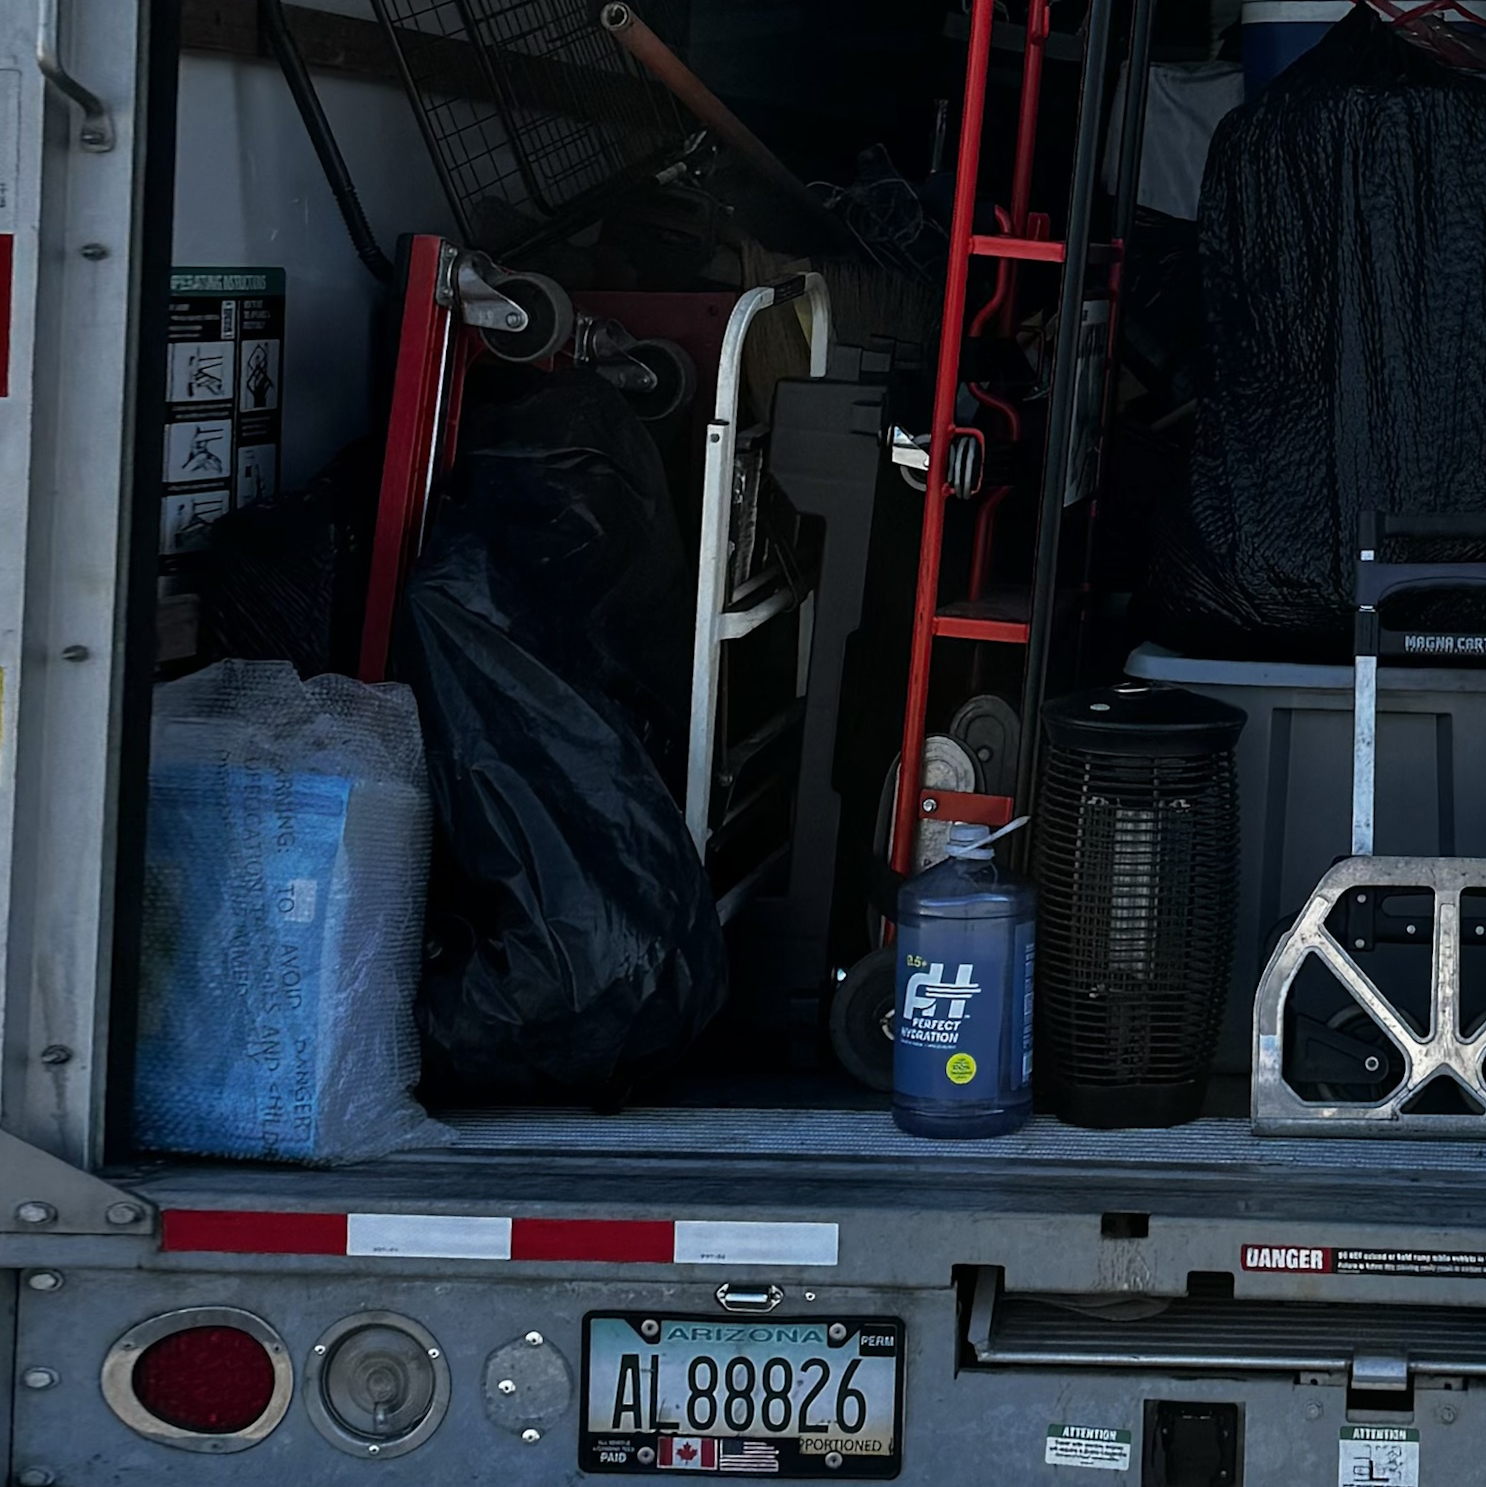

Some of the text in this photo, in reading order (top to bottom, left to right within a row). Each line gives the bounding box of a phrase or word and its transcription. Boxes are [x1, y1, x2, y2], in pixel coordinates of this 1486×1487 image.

[1404, 635, 1455, 653] MAGNA
[273, 756, 297, 854] ARNING:
[243, 757, 265, 894] UFFOCATION
[912, 1017, 962, 1032] PERFECT
[901, 1026, 960, 1044] HYDRATION
[1245, 1246, 1325, 1271] DANGER
[667, 1327, 894, 1347] ARIZONA PERM
[612, 1354, 867, 1434] AL88826
[1062, 1425, 1118, 1441] ATTENTION
[1352, 1427, 1407, 1440] ATTENTION
[799, 1438, 882, 1452] PPORTIONED
[600, 1451, 627, 1463] PAID
